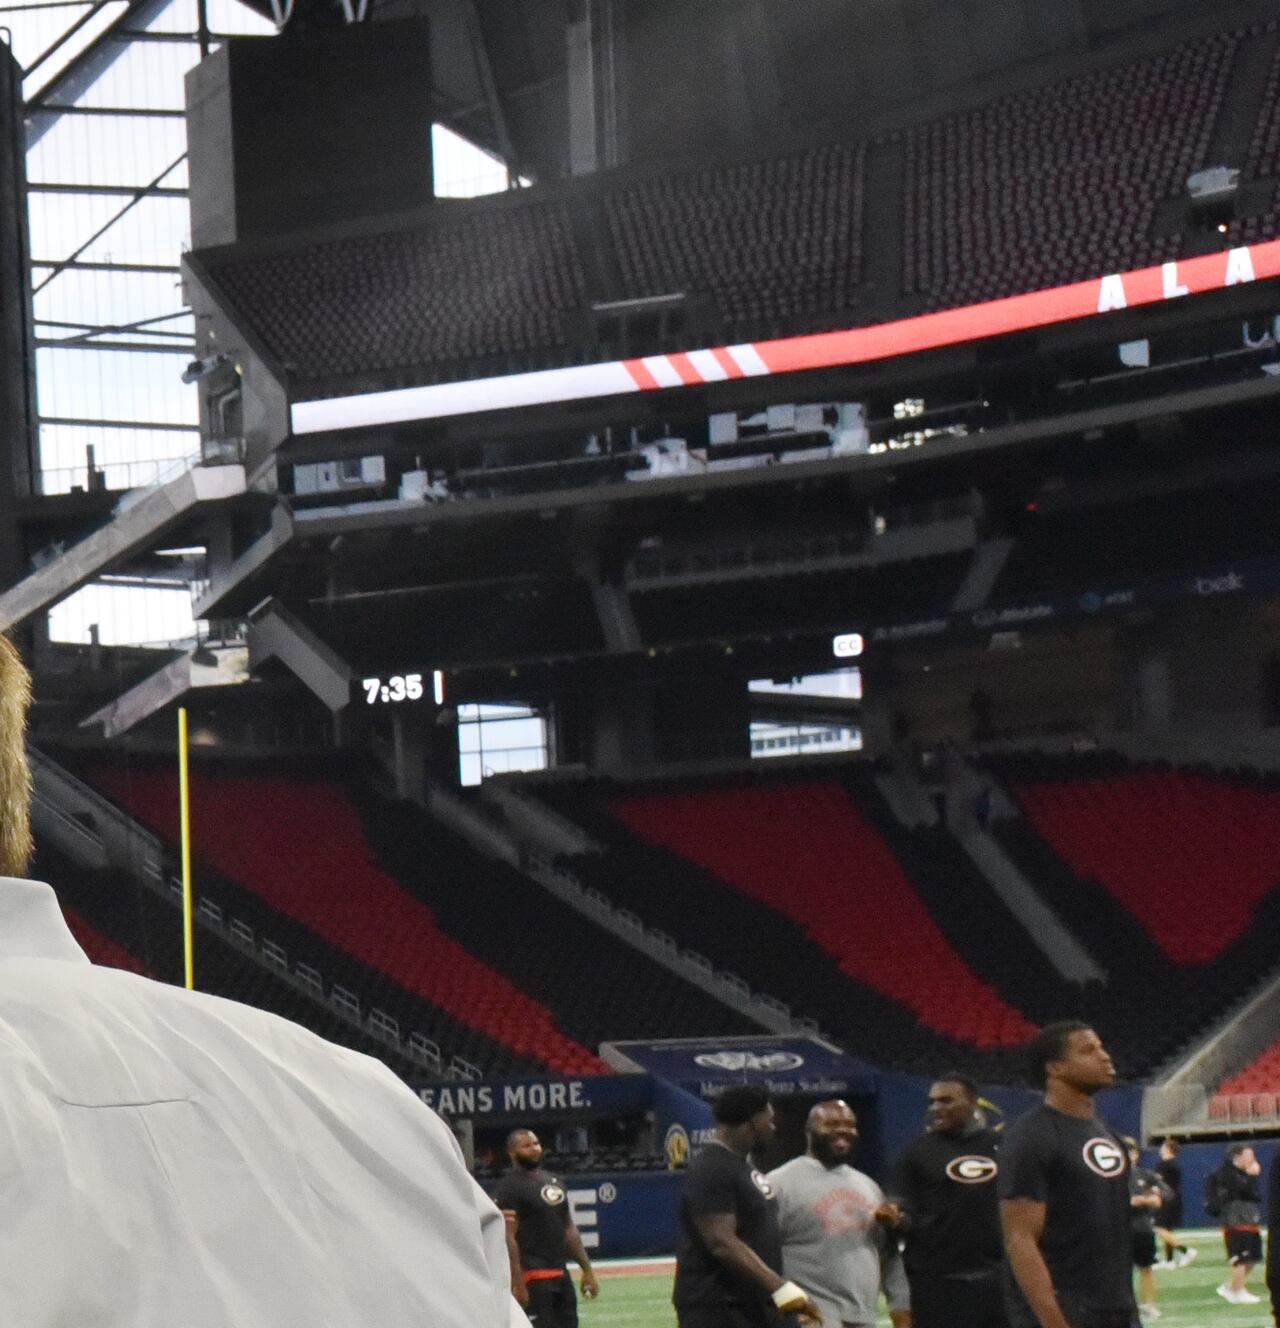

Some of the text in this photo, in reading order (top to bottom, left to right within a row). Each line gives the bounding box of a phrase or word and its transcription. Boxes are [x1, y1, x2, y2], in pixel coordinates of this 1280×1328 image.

[362, 673, 424, 704] 7:35
[419, 1081, 592, 1115] EANS MORE.
